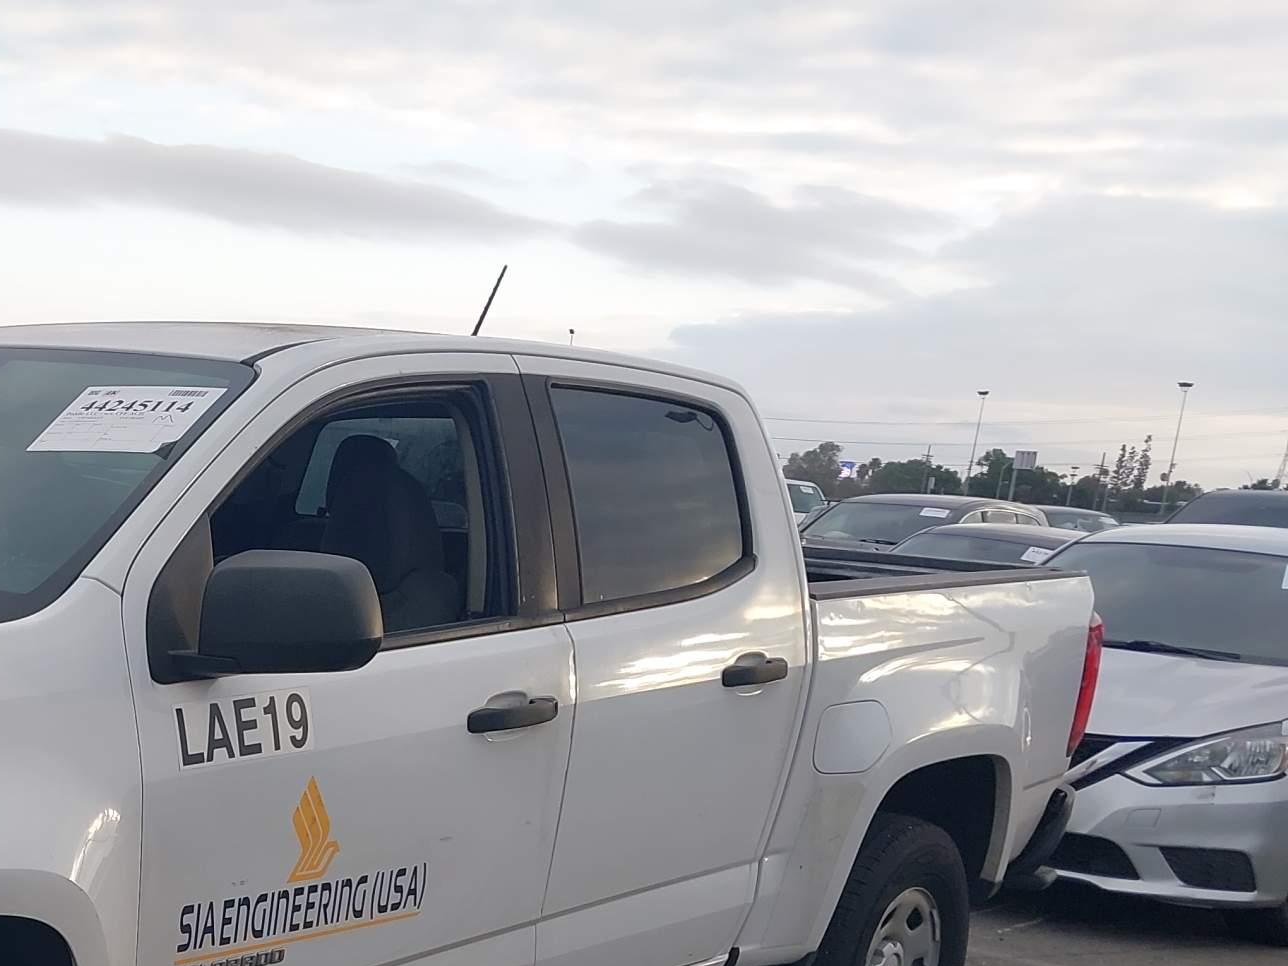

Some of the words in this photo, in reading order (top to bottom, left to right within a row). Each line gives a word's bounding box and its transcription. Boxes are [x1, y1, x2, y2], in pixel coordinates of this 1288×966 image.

[81, 400, 194, 413] 44245114
[175, 693, 309, 766] LAE19
[370, 862, 427, 920] (USA)
